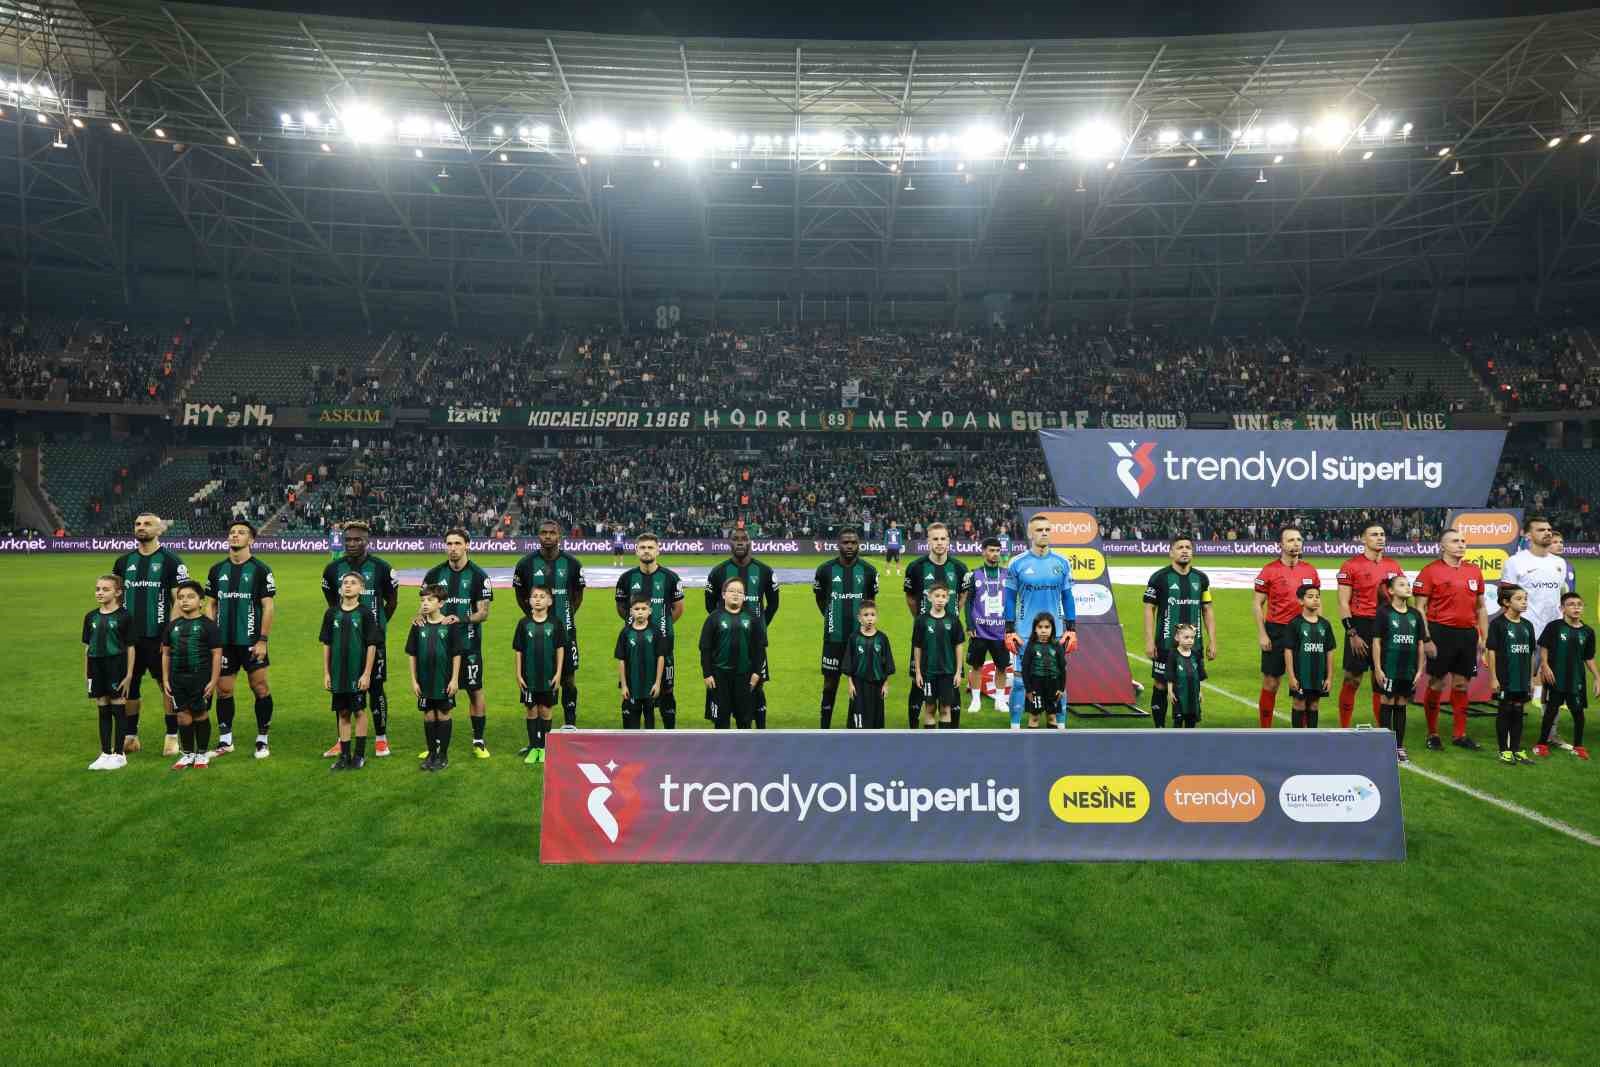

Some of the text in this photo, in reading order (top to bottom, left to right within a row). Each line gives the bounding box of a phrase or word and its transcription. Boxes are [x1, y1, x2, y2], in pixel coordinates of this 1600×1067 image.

[643, 411, 690, 427] 1966
[868, 409, 1001, 429] MEYDAN
[1163, 450, 1442, 488] trendyol SüperLig
[1458, 521, 1513, 537] trendyol
[0, 538, 47, 550] urknet
[188, 538, 230, 551] turkne
[281, 538, 329, 551] turknet
[376, 538, 424, 551] turknet
[469, 540, 517, 551] turknet
[563, 539, 612, 551] turknet
[751, 540, 799, 552] turknet
[957, 541, 983, 552] turk
[1141, 541, 1171, 552] turk
[1234, 542, 1282, 553] turknet
[1325, 542, 1365, 554] turkne
[1417, 543, 1441, 554] turk
[467, 665, 479, 680] 17
[660, 774, 1021, 822] trendyol SüperLig
[1174, 788, 1256, 808] trendyol
[1285, 792, 1355, 802] Türk Telekom
